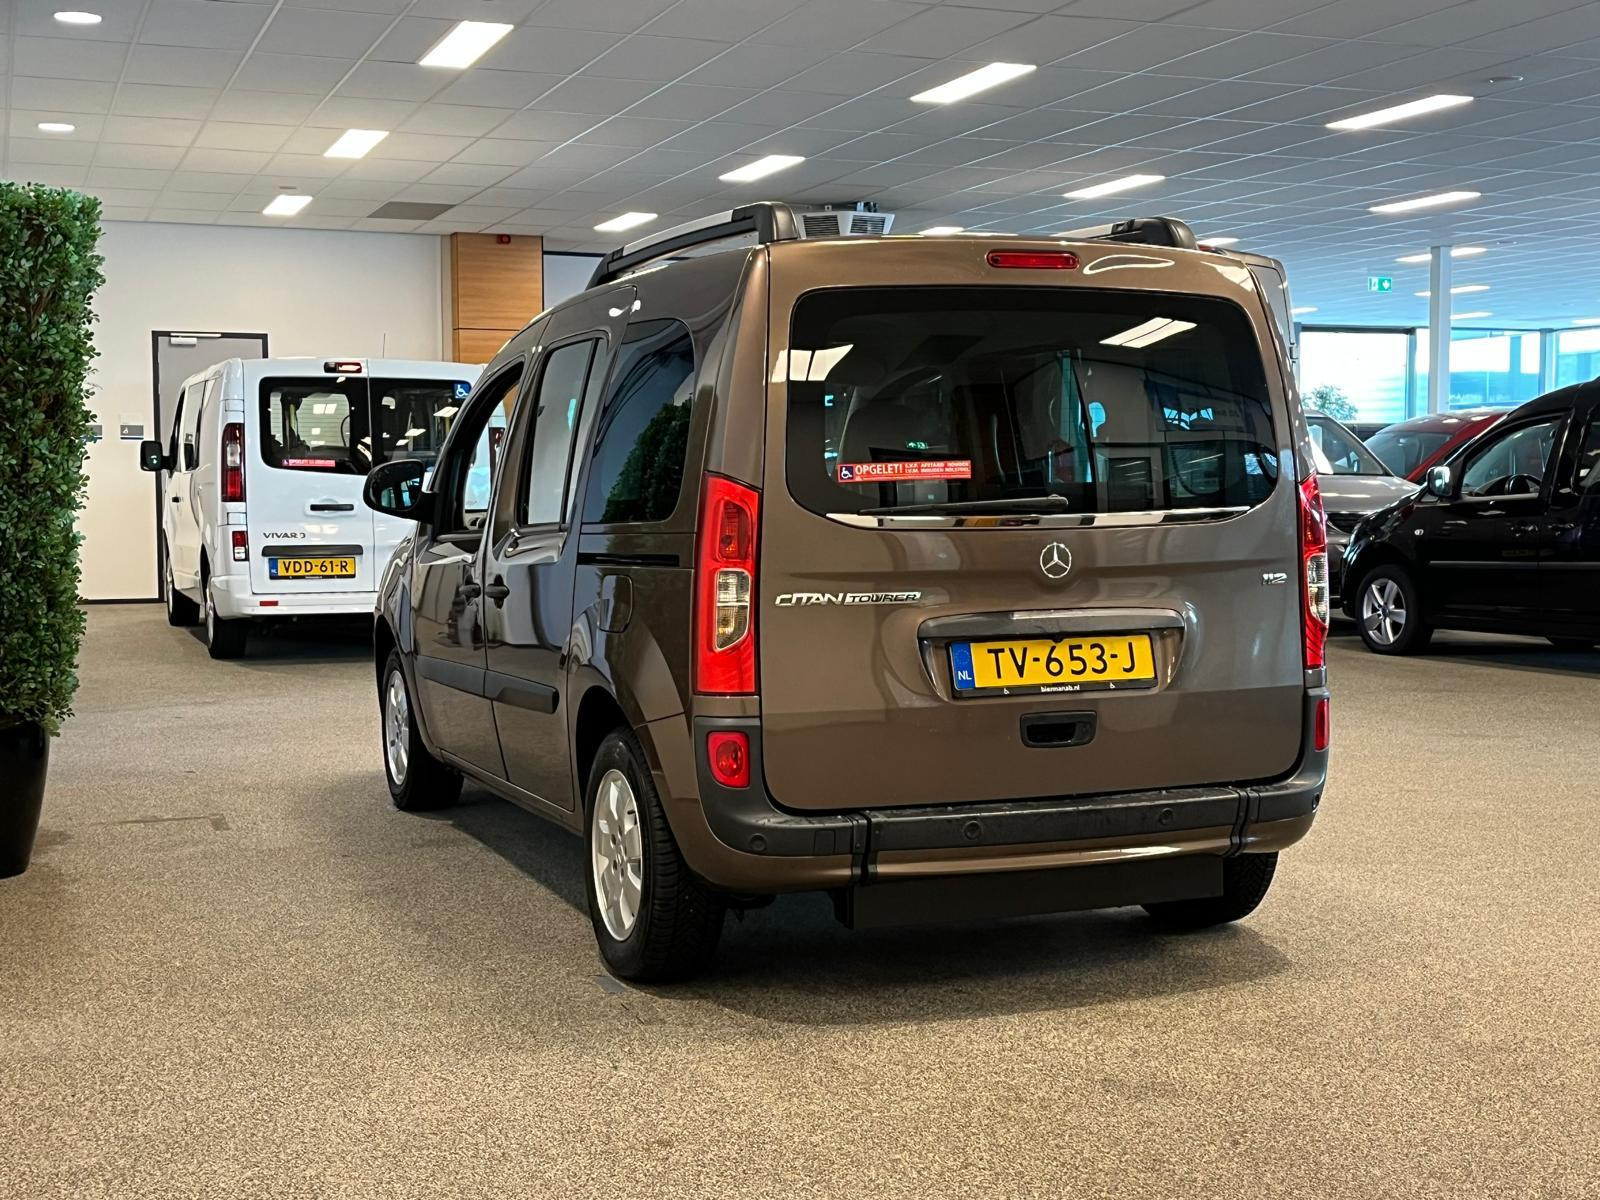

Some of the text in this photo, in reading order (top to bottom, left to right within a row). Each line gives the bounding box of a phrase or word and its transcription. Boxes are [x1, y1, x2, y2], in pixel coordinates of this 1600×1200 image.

[855, 463, 903, 475] OPGELET!
[282, 560, 349, 574] VDD-61-R
[1262, 572, 1288, 585] 112
[774, 592, 844, 606] CITAN
[986, 642, 1137, 680] TV-653-J
[957, 670, 973, 681] NL
[1040, 684, 1081, 693] biermanab.nl
